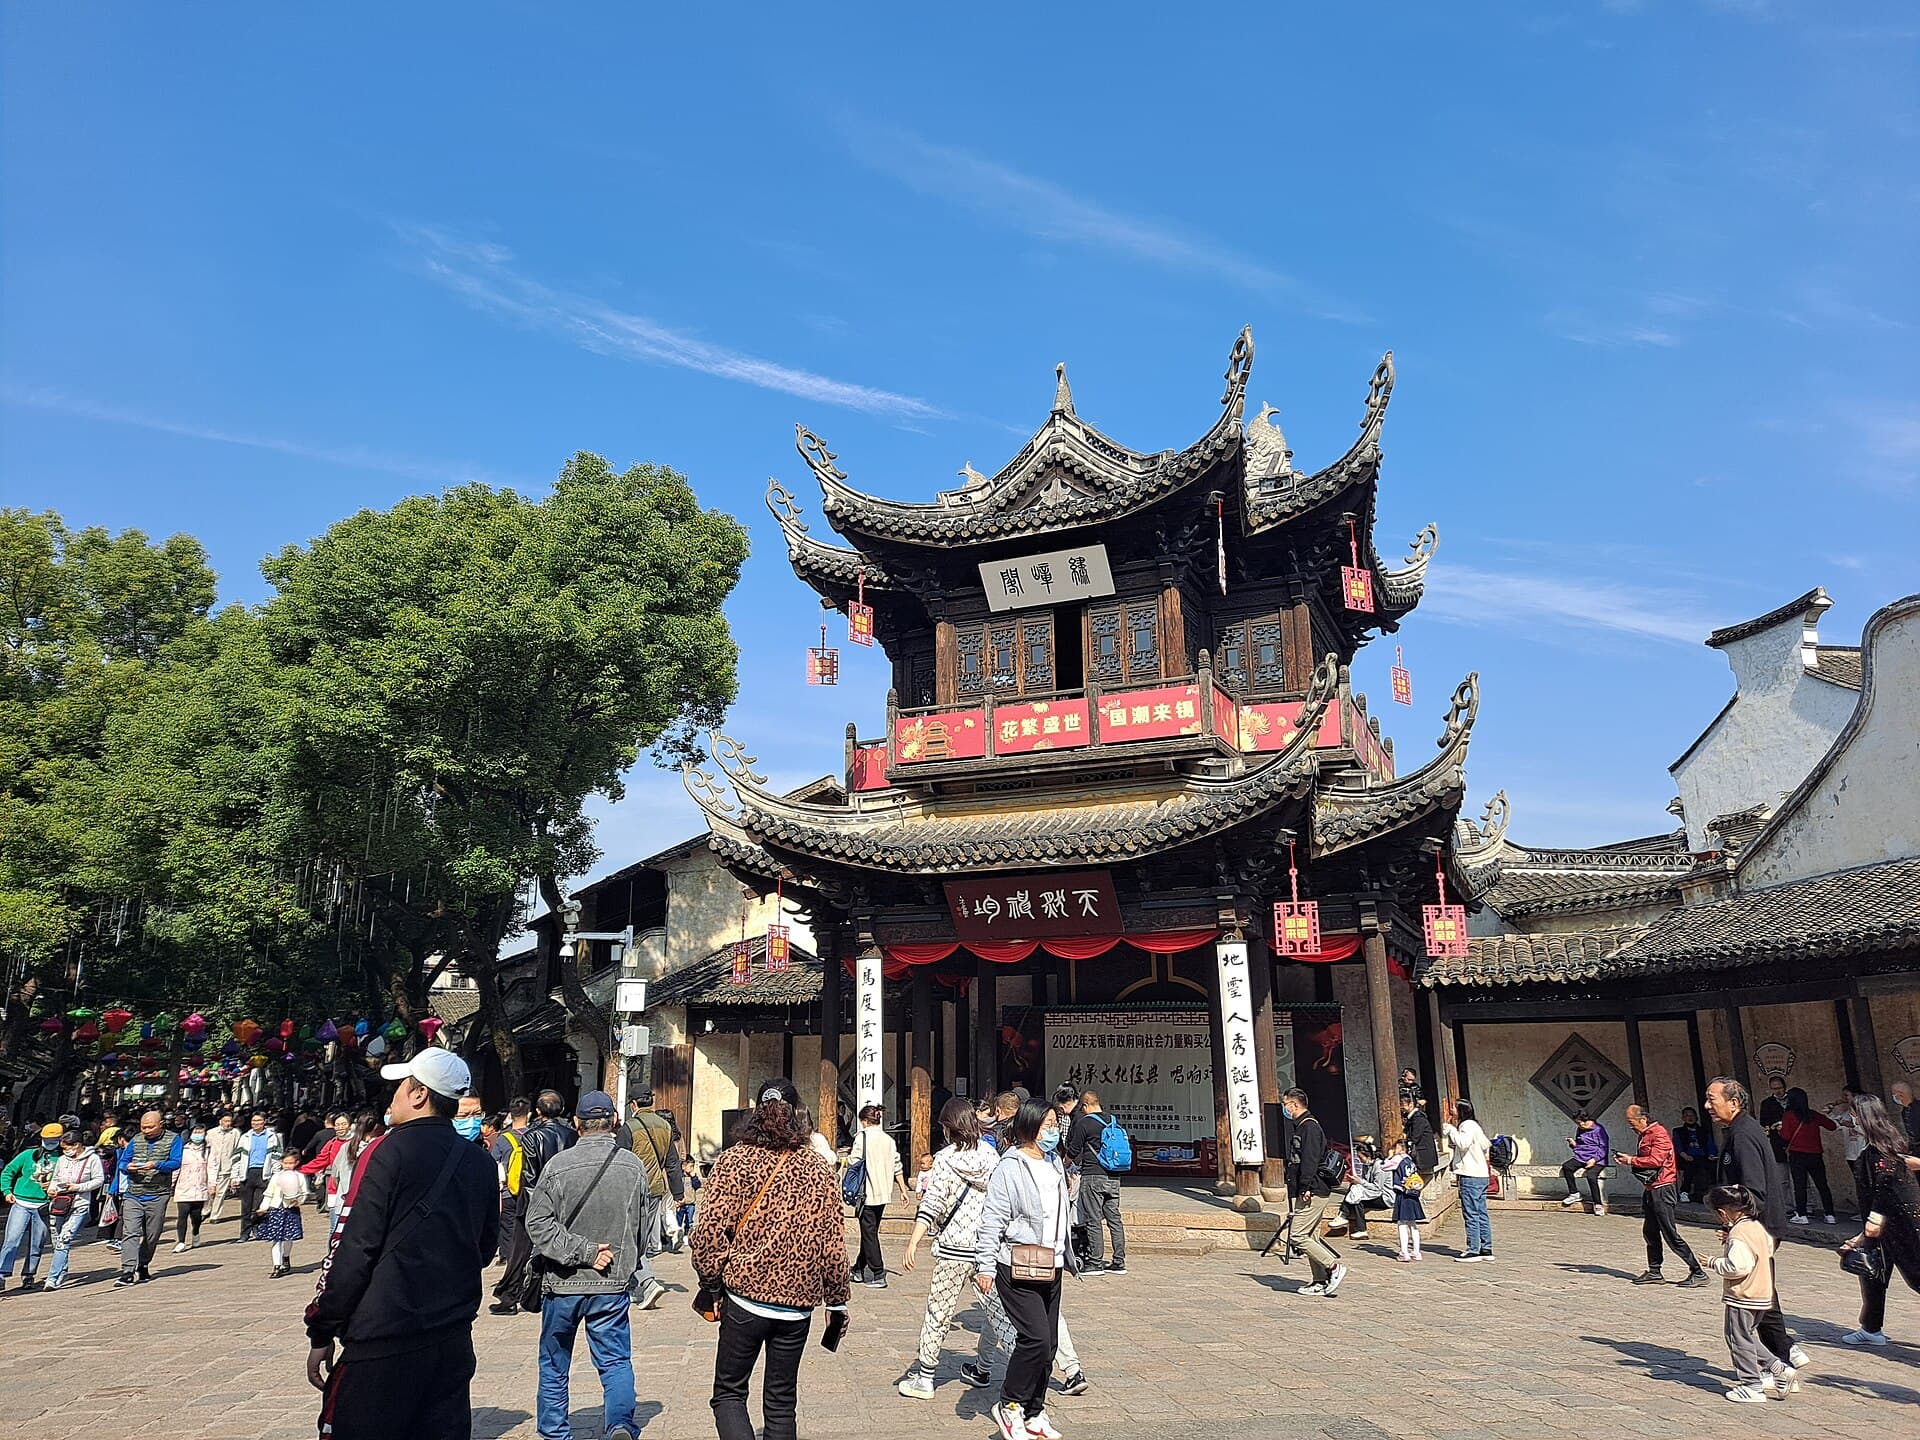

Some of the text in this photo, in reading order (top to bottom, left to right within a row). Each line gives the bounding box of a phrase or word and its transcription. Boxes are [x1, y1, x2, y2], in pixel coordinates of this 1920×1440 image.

[1001, 713, 1081, 739] 花繁盛世
[1109, 700, 1195, 727] 国潮来锡
[1067, 1063, 1159, 1085] 传承文化经典
